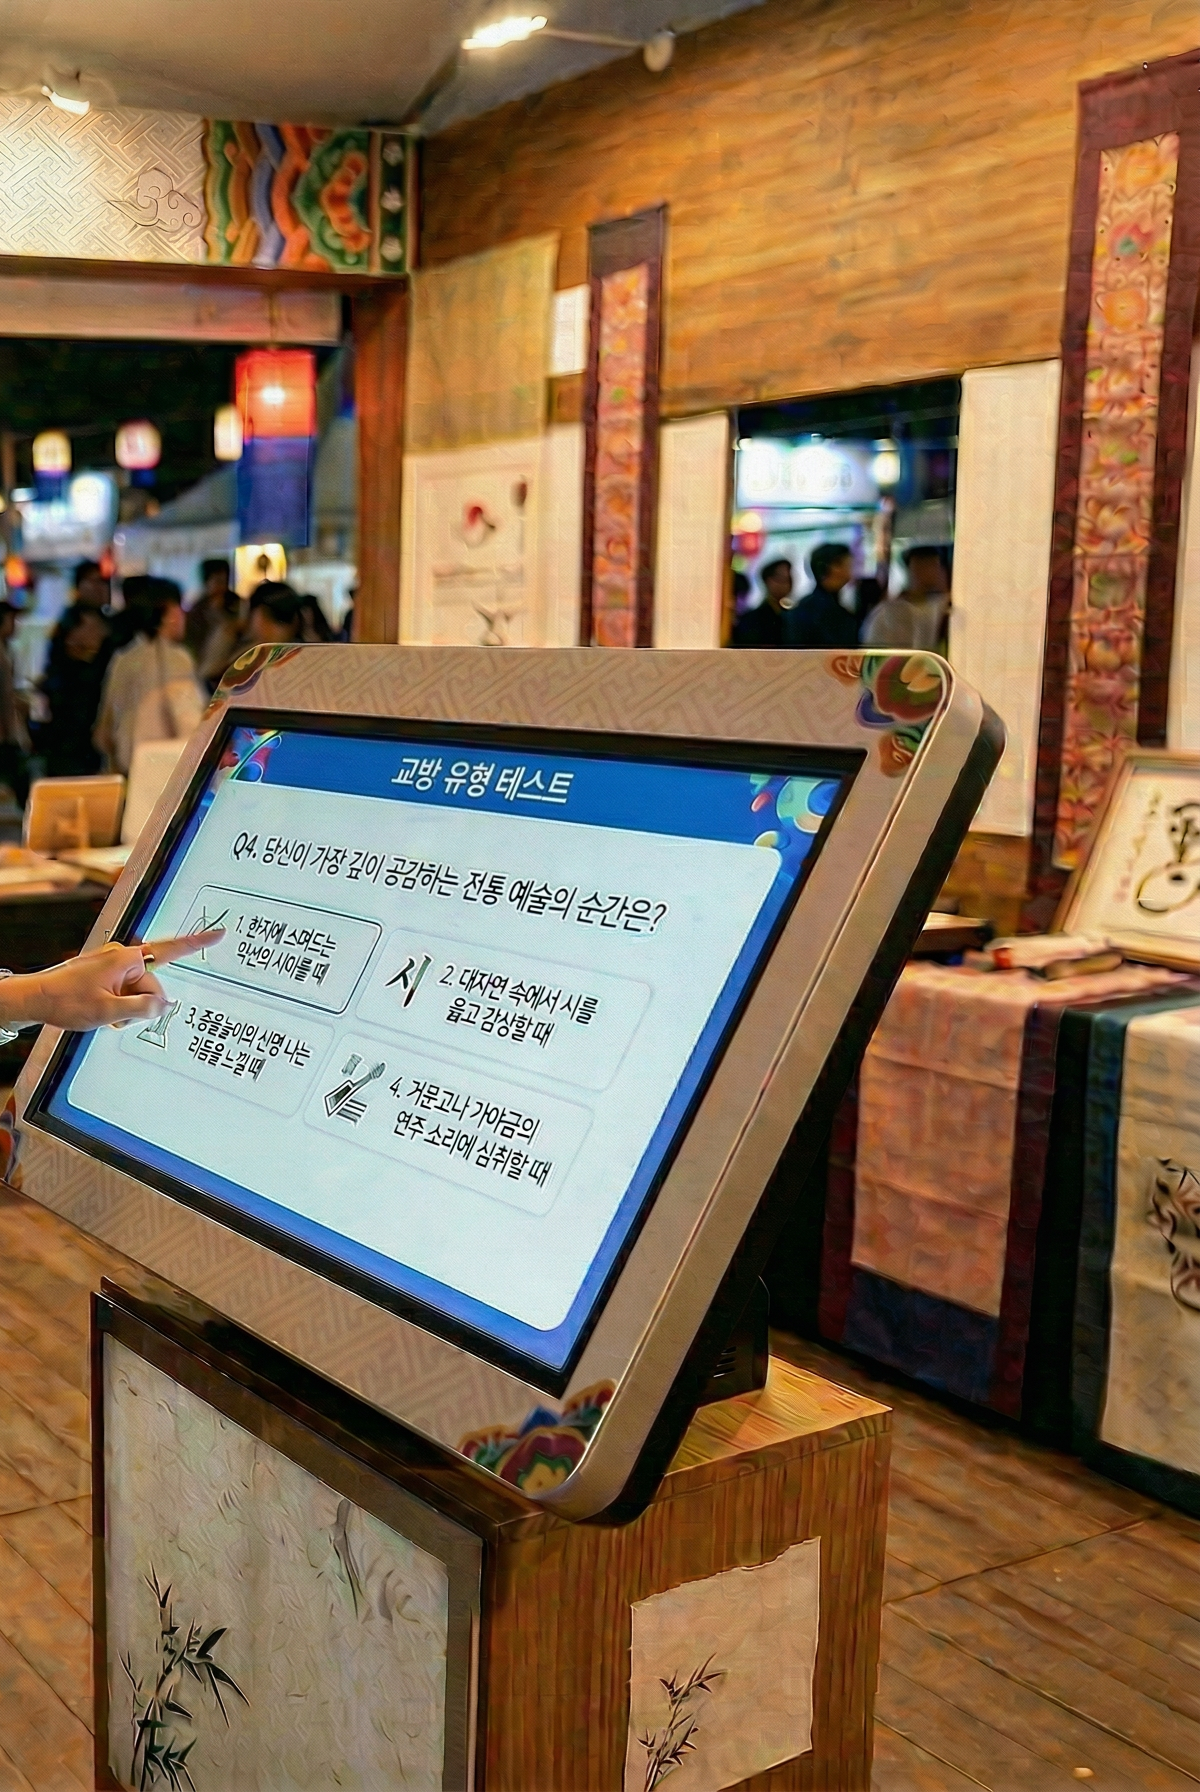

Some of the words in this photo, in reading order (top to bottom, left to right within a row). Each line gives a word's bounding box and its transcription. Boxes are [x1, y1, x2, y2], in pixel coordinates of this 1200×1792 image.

[391, 757, 442, 791] 교방
[444, 761, 495, 798] 유형
[495, 766, 574, 804] 테스트
[233, 832, 258, 860] Q4.
[262, 837, 312, 870] 당신이
[310, 846, 347, 875] 가장
[346, 851, 385, 883] 깊이
[384, 857, 459, 896] 공감하는
[463, 871, 506, 905] 전통
[508, 879, 578, 920] 예술의
[576, 891, 667, 932] 순간은?
[235, 915, 244, 934] 1.
[246, 916, 288, 945] 한지에
[283, 929, 336, 958] 스며드는
[439, 965, 453, 986] 2.
[458, 968, 509, 1001] 대자연
[508, 980, 562, 1015] 속에서
[560, 994, 599, 1025] 시를
[256, 1029, 286, 1057] 신명
[283, 1039, 310, 1067] 나는
[480, 1007, 534, 1042] 감상할
[532, 1022, 555, 1048] 때
[188, 1036, 225, 1067] 리듬을
[221, 1049, 251, 1076] 느낄
[389, 1077, 402, 1098] 4.
[406, 1079, 470, 1121] 거문고나
[469, 1101, 541, 1146] 가야금의
[394, 1110, 427, 1140] 연주
[424, 1124, 478, 1160] 소리에
[475, 1140, 529, 1180] 심취할
[528, 1159, 553, 1188] 때
